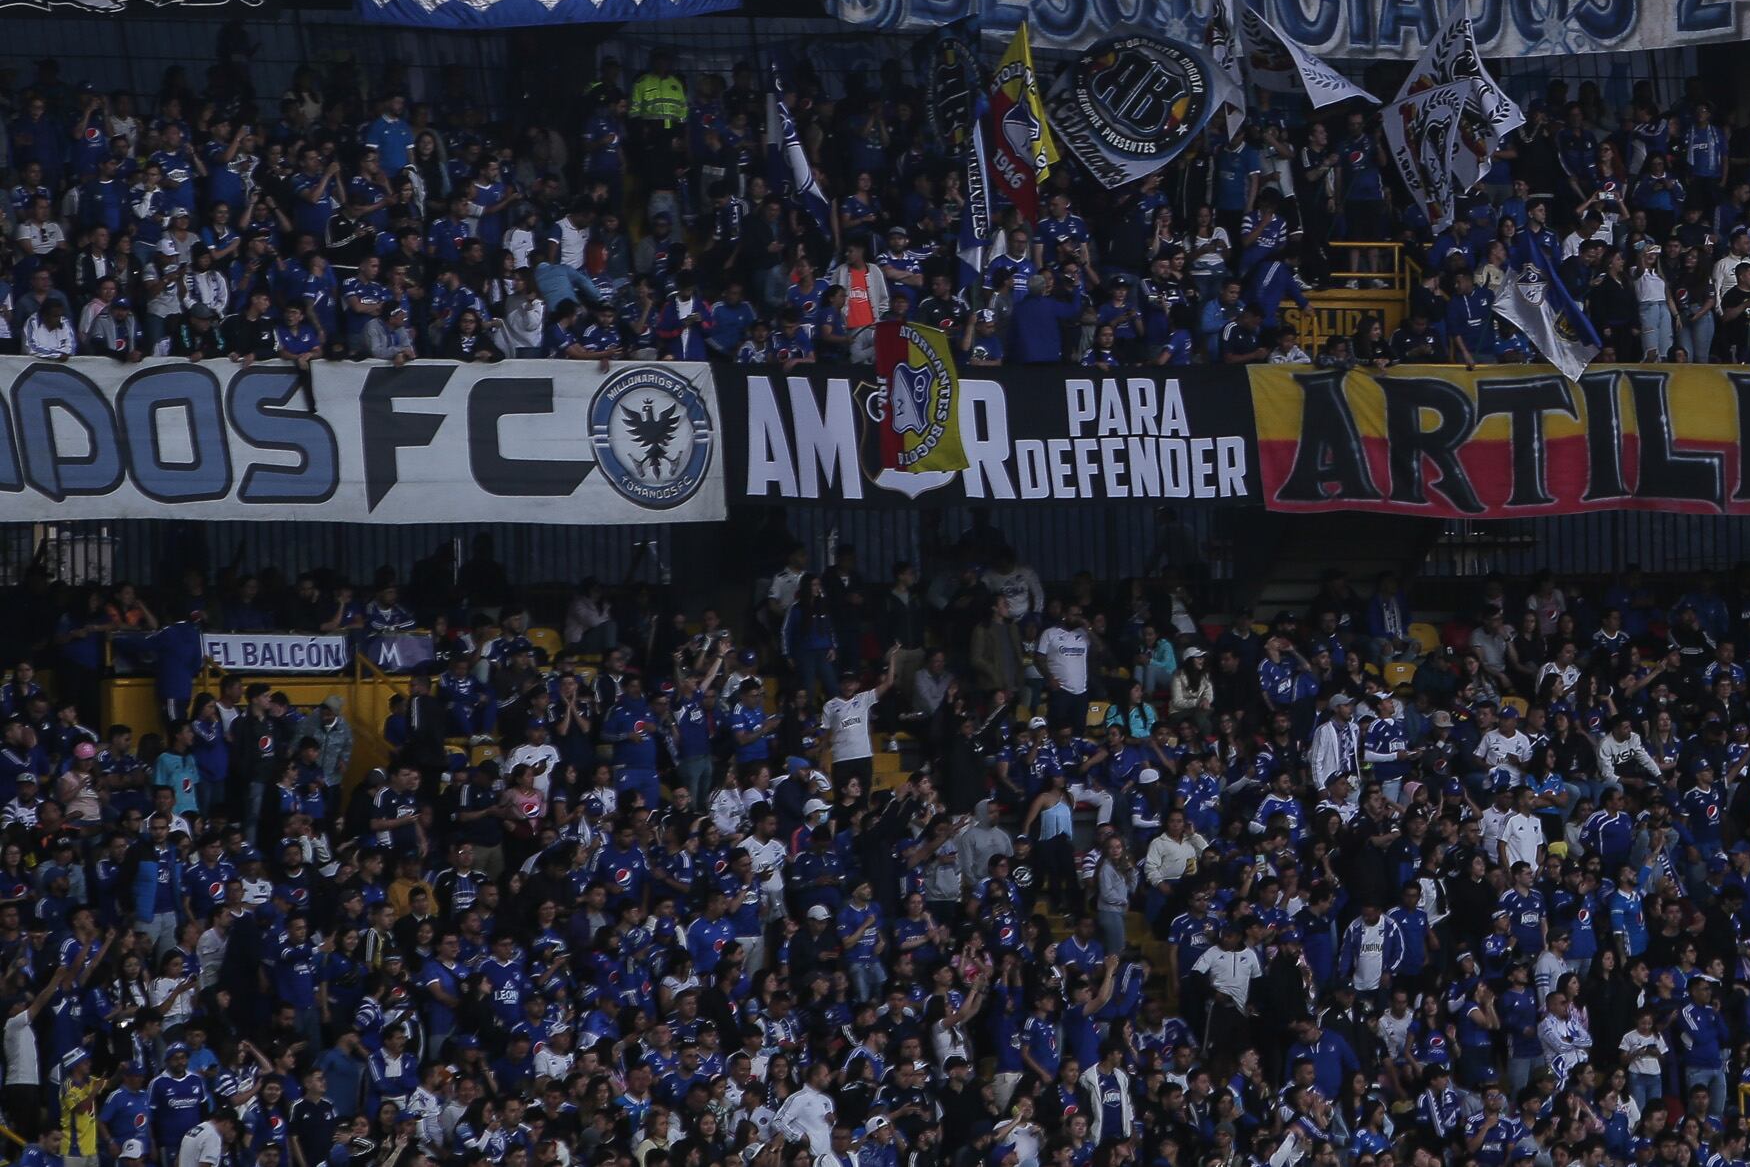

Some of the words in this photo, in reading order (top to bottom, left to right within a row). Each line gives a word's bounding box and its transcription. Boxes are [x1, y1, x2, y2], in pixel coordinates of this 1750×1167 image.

[1075, 87, 1104, 131] SIEMPRE
[1100, 125, 1158, 155] PRESENTES
[1284, 308, 1379, 336] SALID
[1066, 378, 1191, 437] PARA
[0, 364, 340, 505] DOS
[360, 364, 598, 514] FC
[1017, 435, 1248, 499] DEFENDER
[207, 641, 235, 666] EL
[241, 638, 342, 668] BALCÓN
